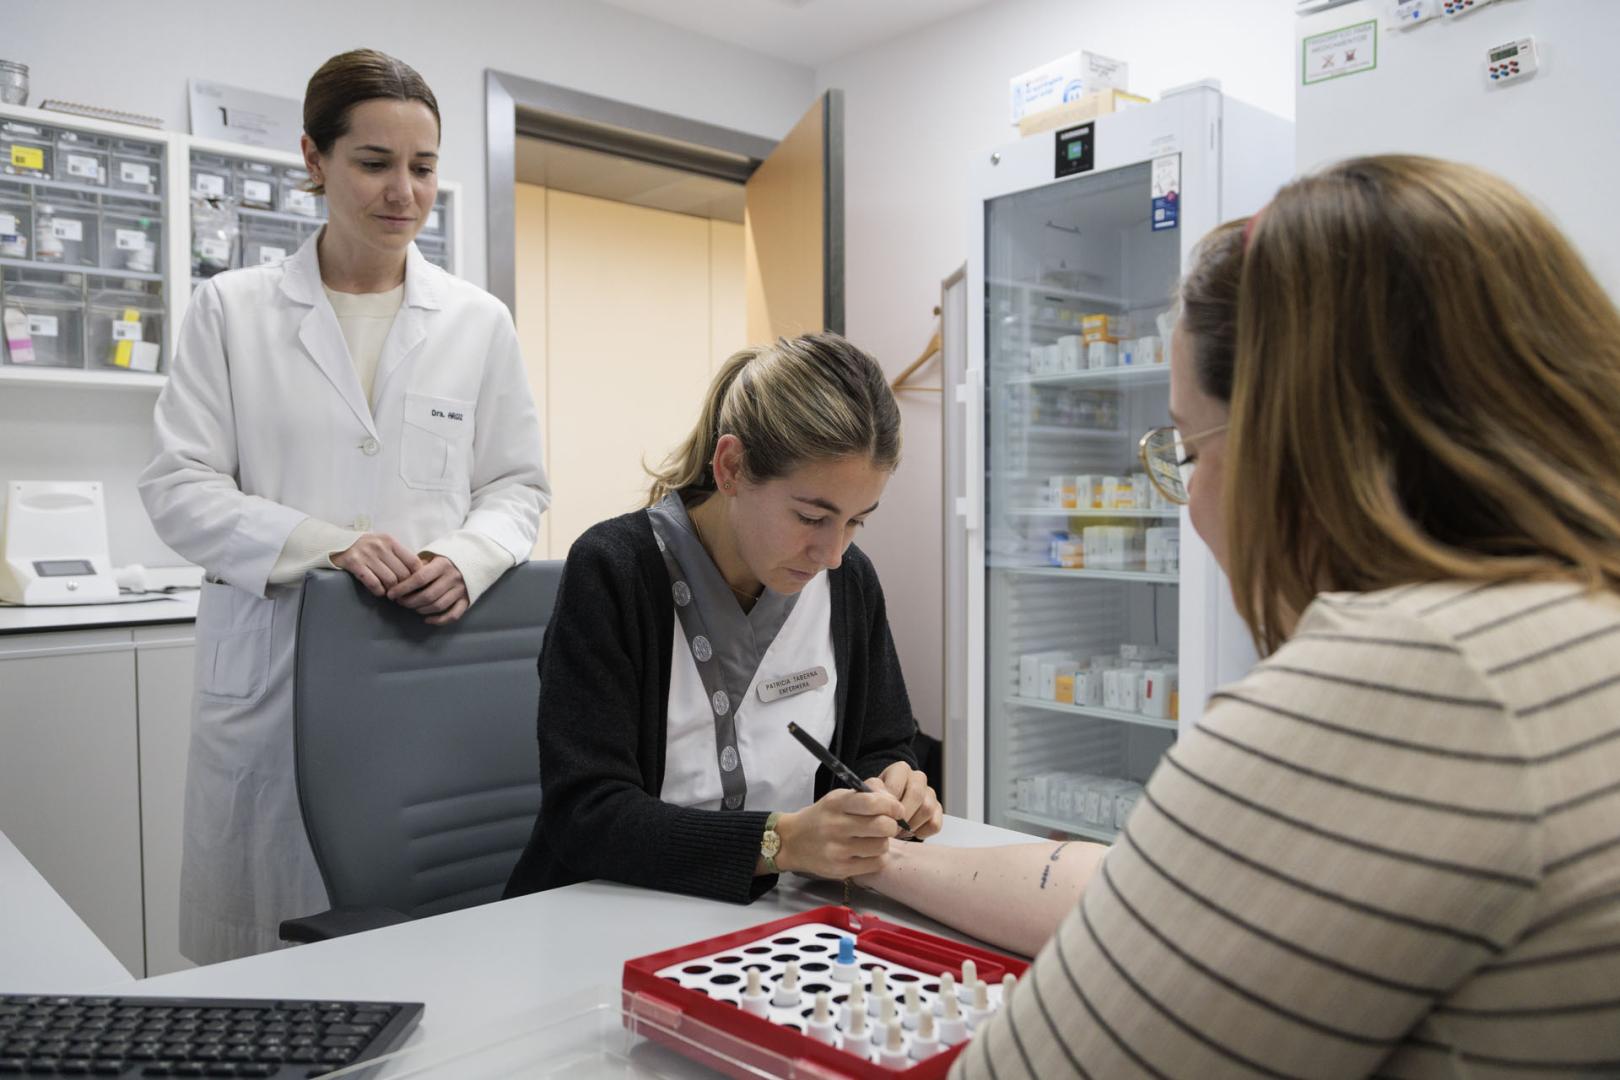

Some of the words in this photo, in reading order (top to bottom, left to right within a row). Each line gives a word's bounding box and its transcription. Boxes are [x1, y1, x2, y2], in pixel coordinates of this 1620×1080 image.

[765, 680, 790, 690] PATRICIA
[793, 671, 818, 681] TABERNA
[779, 682, 809, 695] ENFERMERA
